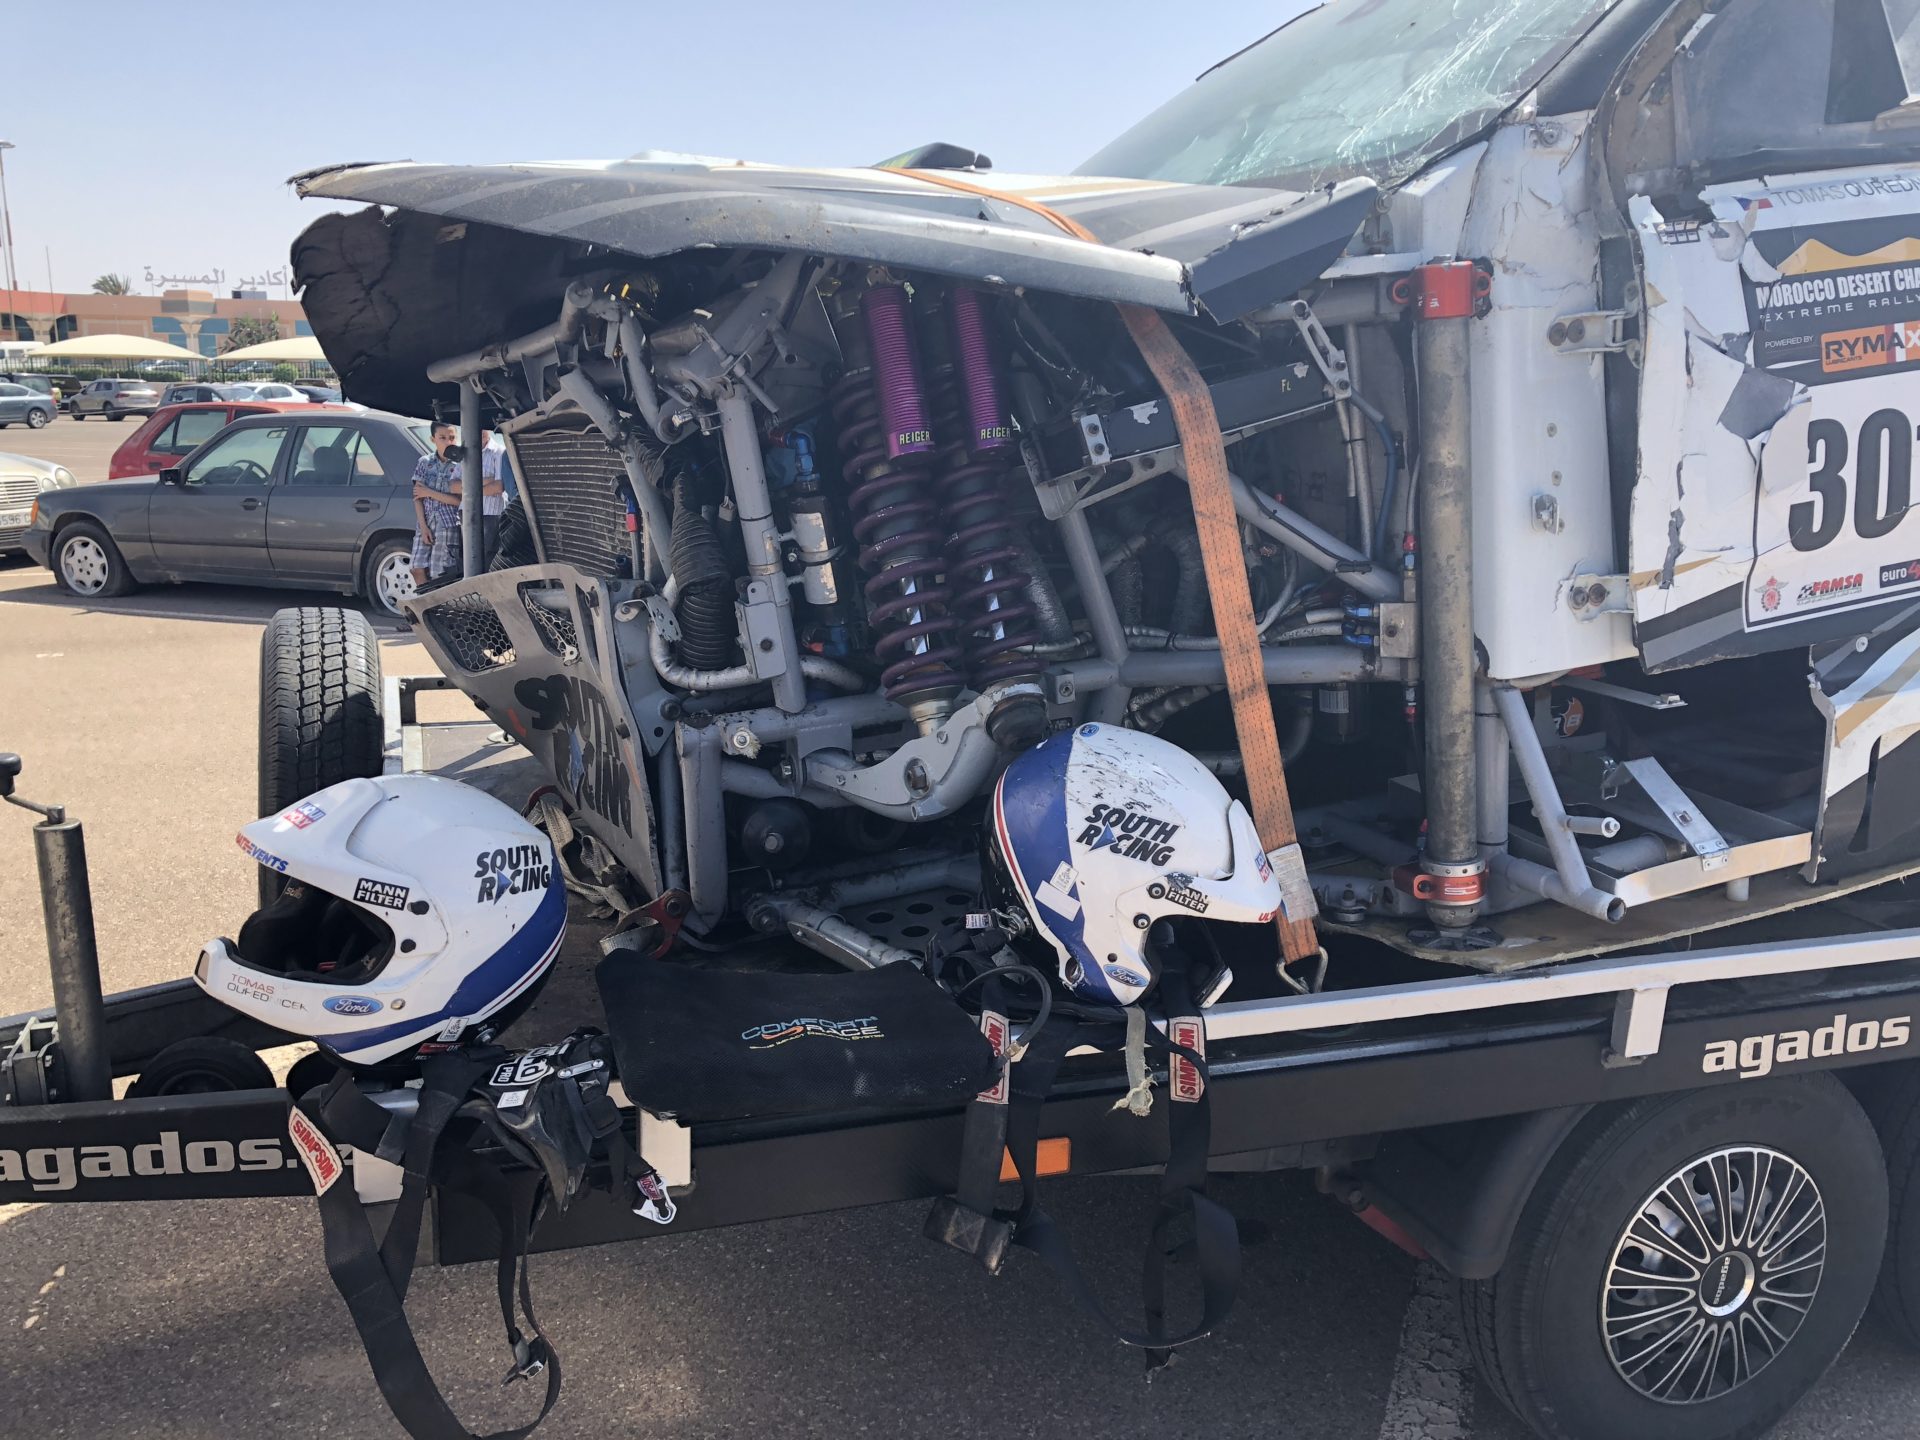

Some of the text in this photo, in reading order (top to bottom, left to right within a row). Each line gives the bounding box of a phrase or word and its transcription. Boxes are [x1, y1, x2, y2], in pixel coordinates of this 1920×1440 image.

[144, 265, 225, 287] المسيرة
[1756, 277, 1835, 309] MOROCCO
[1837, 271, 1892, 298] DESERT
[1765, 335, 1814, 349] POWERED BY
[900, 431, 930, 445] REIGER
[981, 427, 1010, 440] REIGER
[1812, 573, 1864, 596] FAMSA
[1085, 804, 1179, 844] SOUTH
[474, 844, 543, 878] SOUTH
[356, 890, 404, 909] FILTER
[359, 880, 408, 898] MANN
[1167, 892, 1206, 912] FILTER
[231, 974, 275, 995] TOMAS
[1703, 1014, 1911, 1079] agados
[497, 1066, 514, 1083] PRO
[292, 1120, 335, 1181] SIMPSON
[1713, 1257, 1730, 1304] agados
